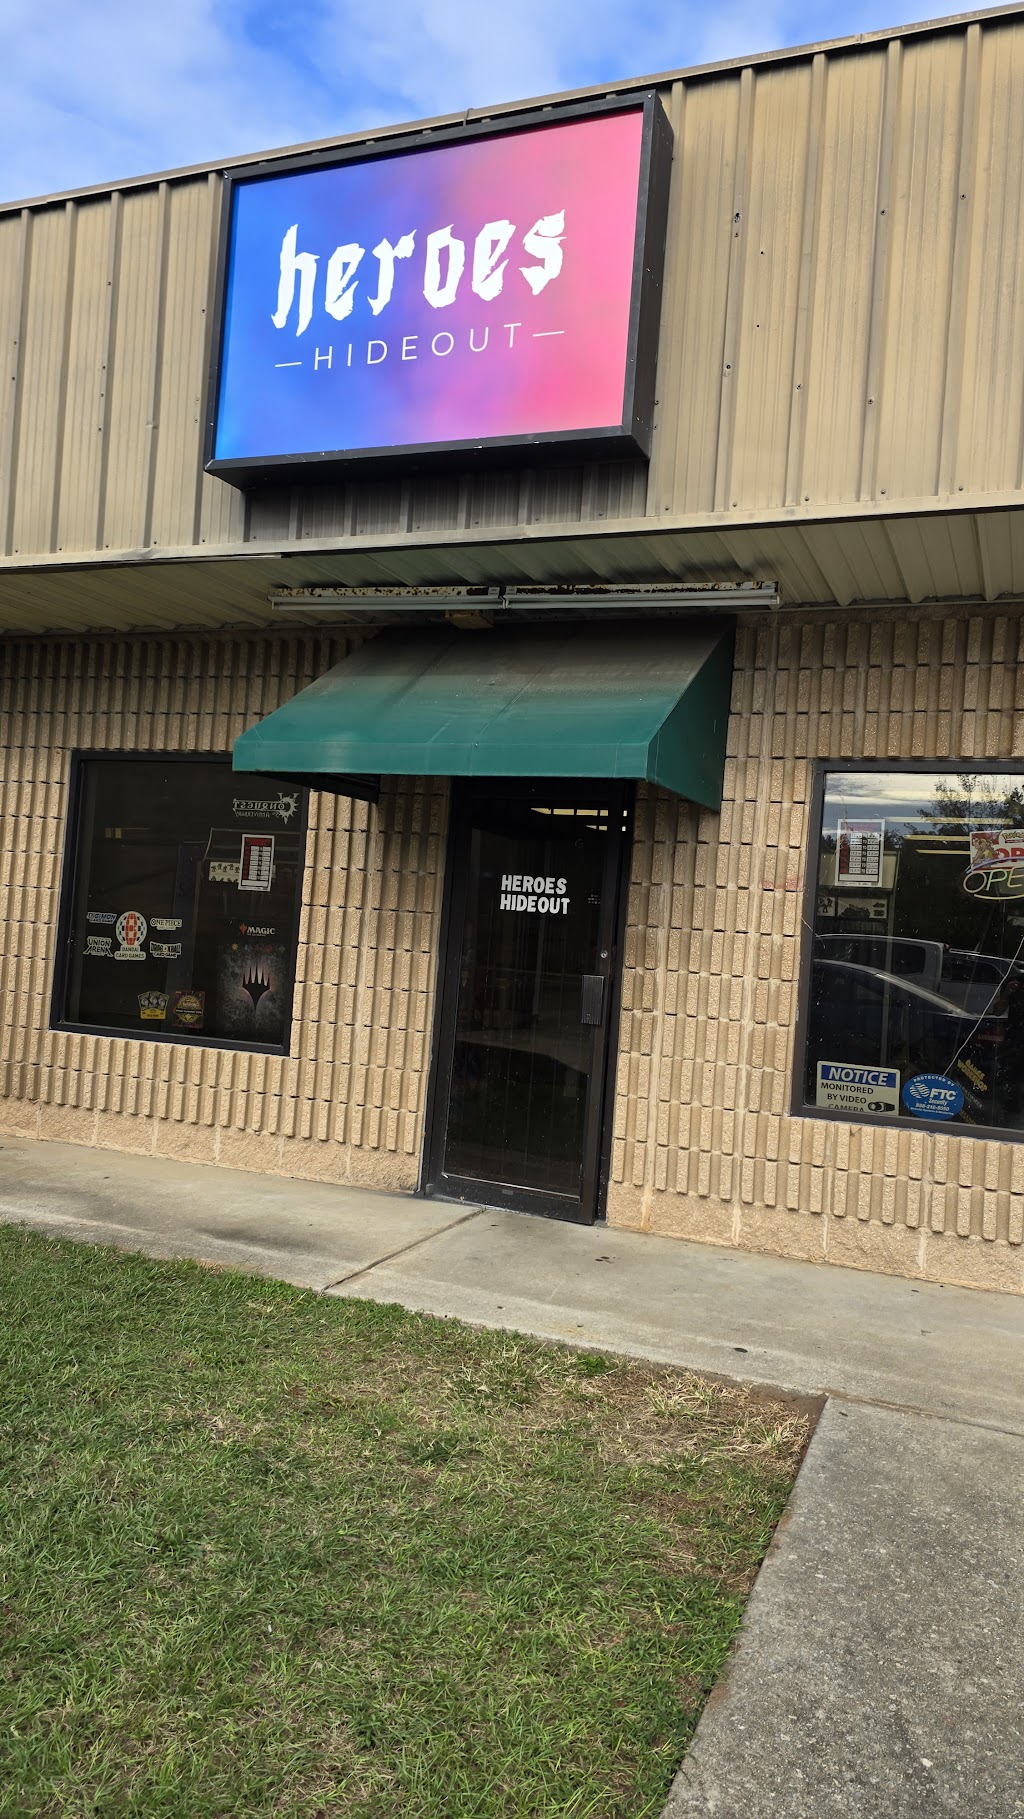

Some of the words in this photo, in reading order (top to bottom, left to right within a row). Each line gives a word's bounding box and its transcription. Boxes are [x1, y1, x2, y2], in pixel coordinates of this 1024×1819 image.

[270, 208, 568, 338] heroes
[313, 322, 523, 371] HIDEOUT
[501, 874, 568, 896] HEROES
[499, 894, 571, 915] HIDEOUT
[87, 912, 117, 920] DIGIMON
[150, 918, 164, 927] ONE
[164, 919, 182, 927] PIECE
[246, 926, 276, 935] MAGIC
[88, 938, 111, 947] UNION
[83, 945, 114, 957] ARENA
[828, 1067, 889, 1085] NOTICE
[913, 1075, 946, 1083] PROTECTED
[957, 1059, 988, 1092] WORKSHOP
[820, 1082, 874, 1095] MONITORED
[930, 1088, 957, 1101] FTC
[827, 1093, 838, 1101] BY
[839, 1095, 867, 1104] VIDEO
[928, 1098, 948, 1106] Security
